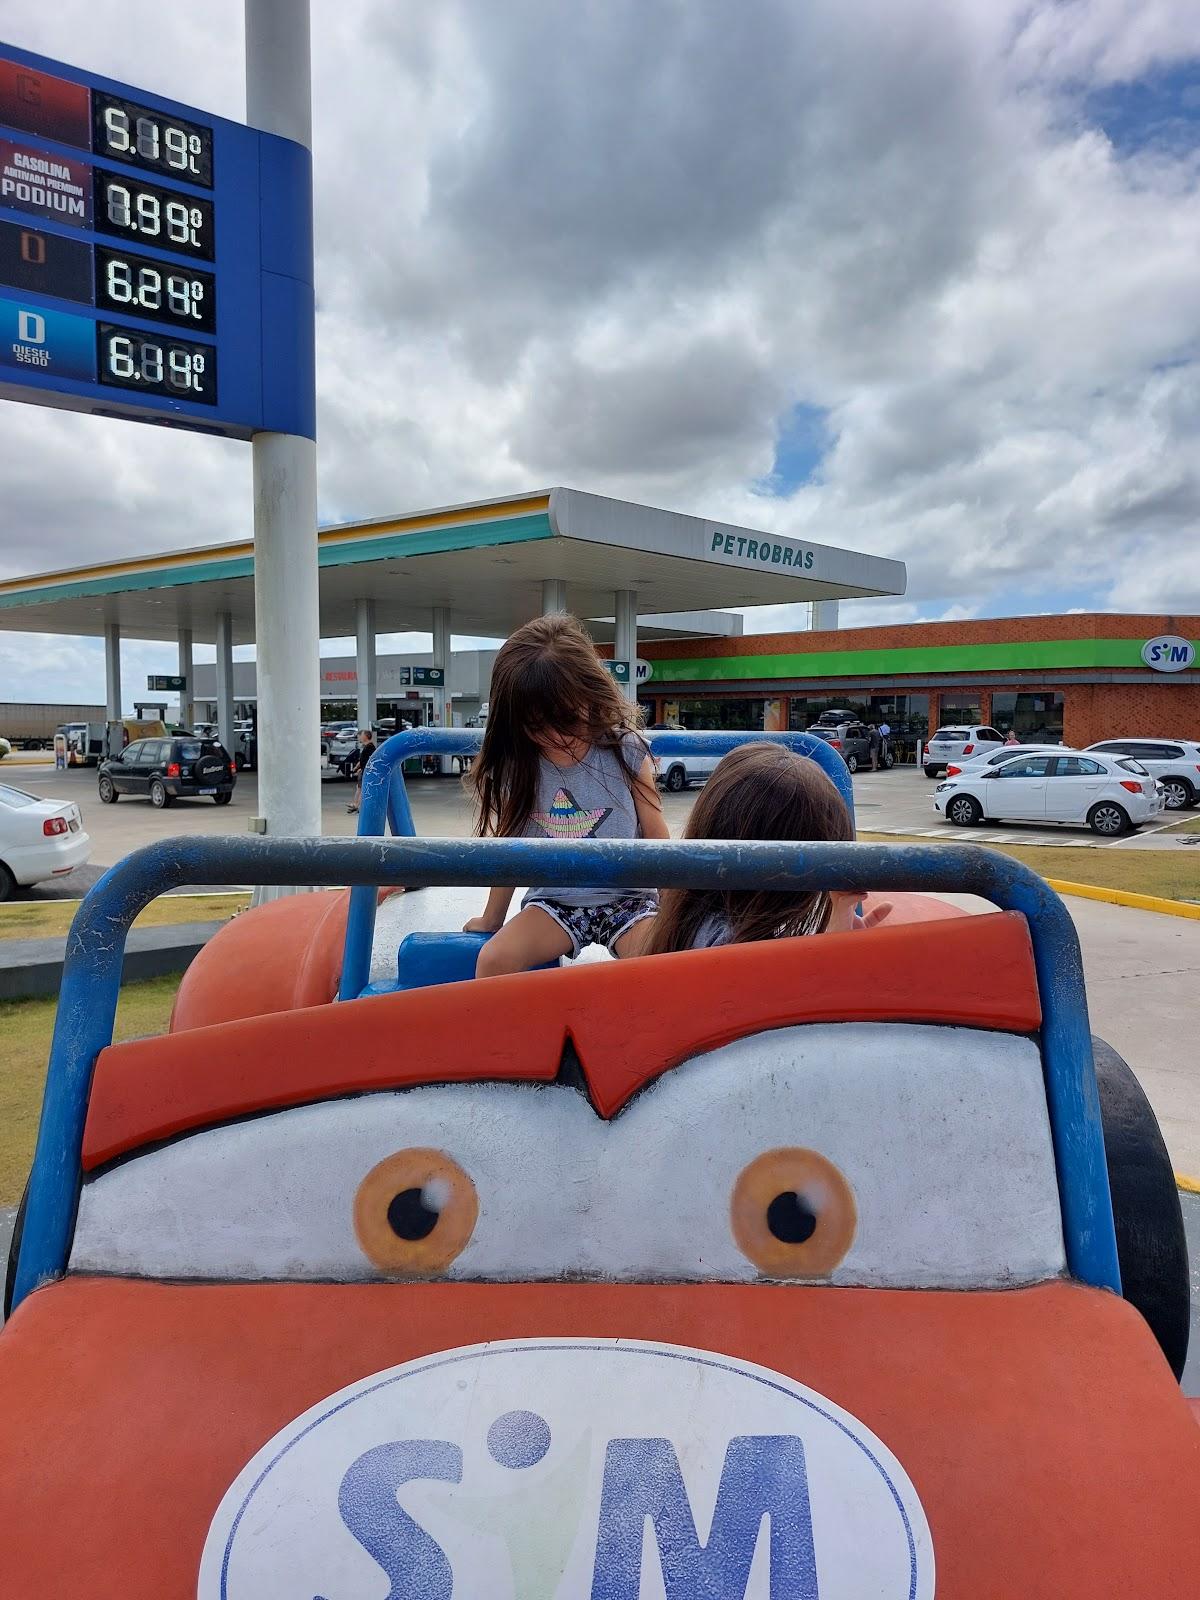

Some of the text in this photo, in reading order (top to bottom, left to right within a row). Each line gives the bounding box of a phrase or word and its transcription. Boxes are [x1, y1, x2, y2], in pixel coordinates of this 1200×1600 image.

[4, 165, 84, 197] ADITIVADA PREMIUM
[14, 152, 71, 181] GASOLINA
[2, 177, 85, 218] PODIUM
[18, 310, 45, 344] D
[13, 344, 52, 360] DIESEL
[16, 353, 48, 367] S500
[711, 532, 814, 569] PETROBRAS
